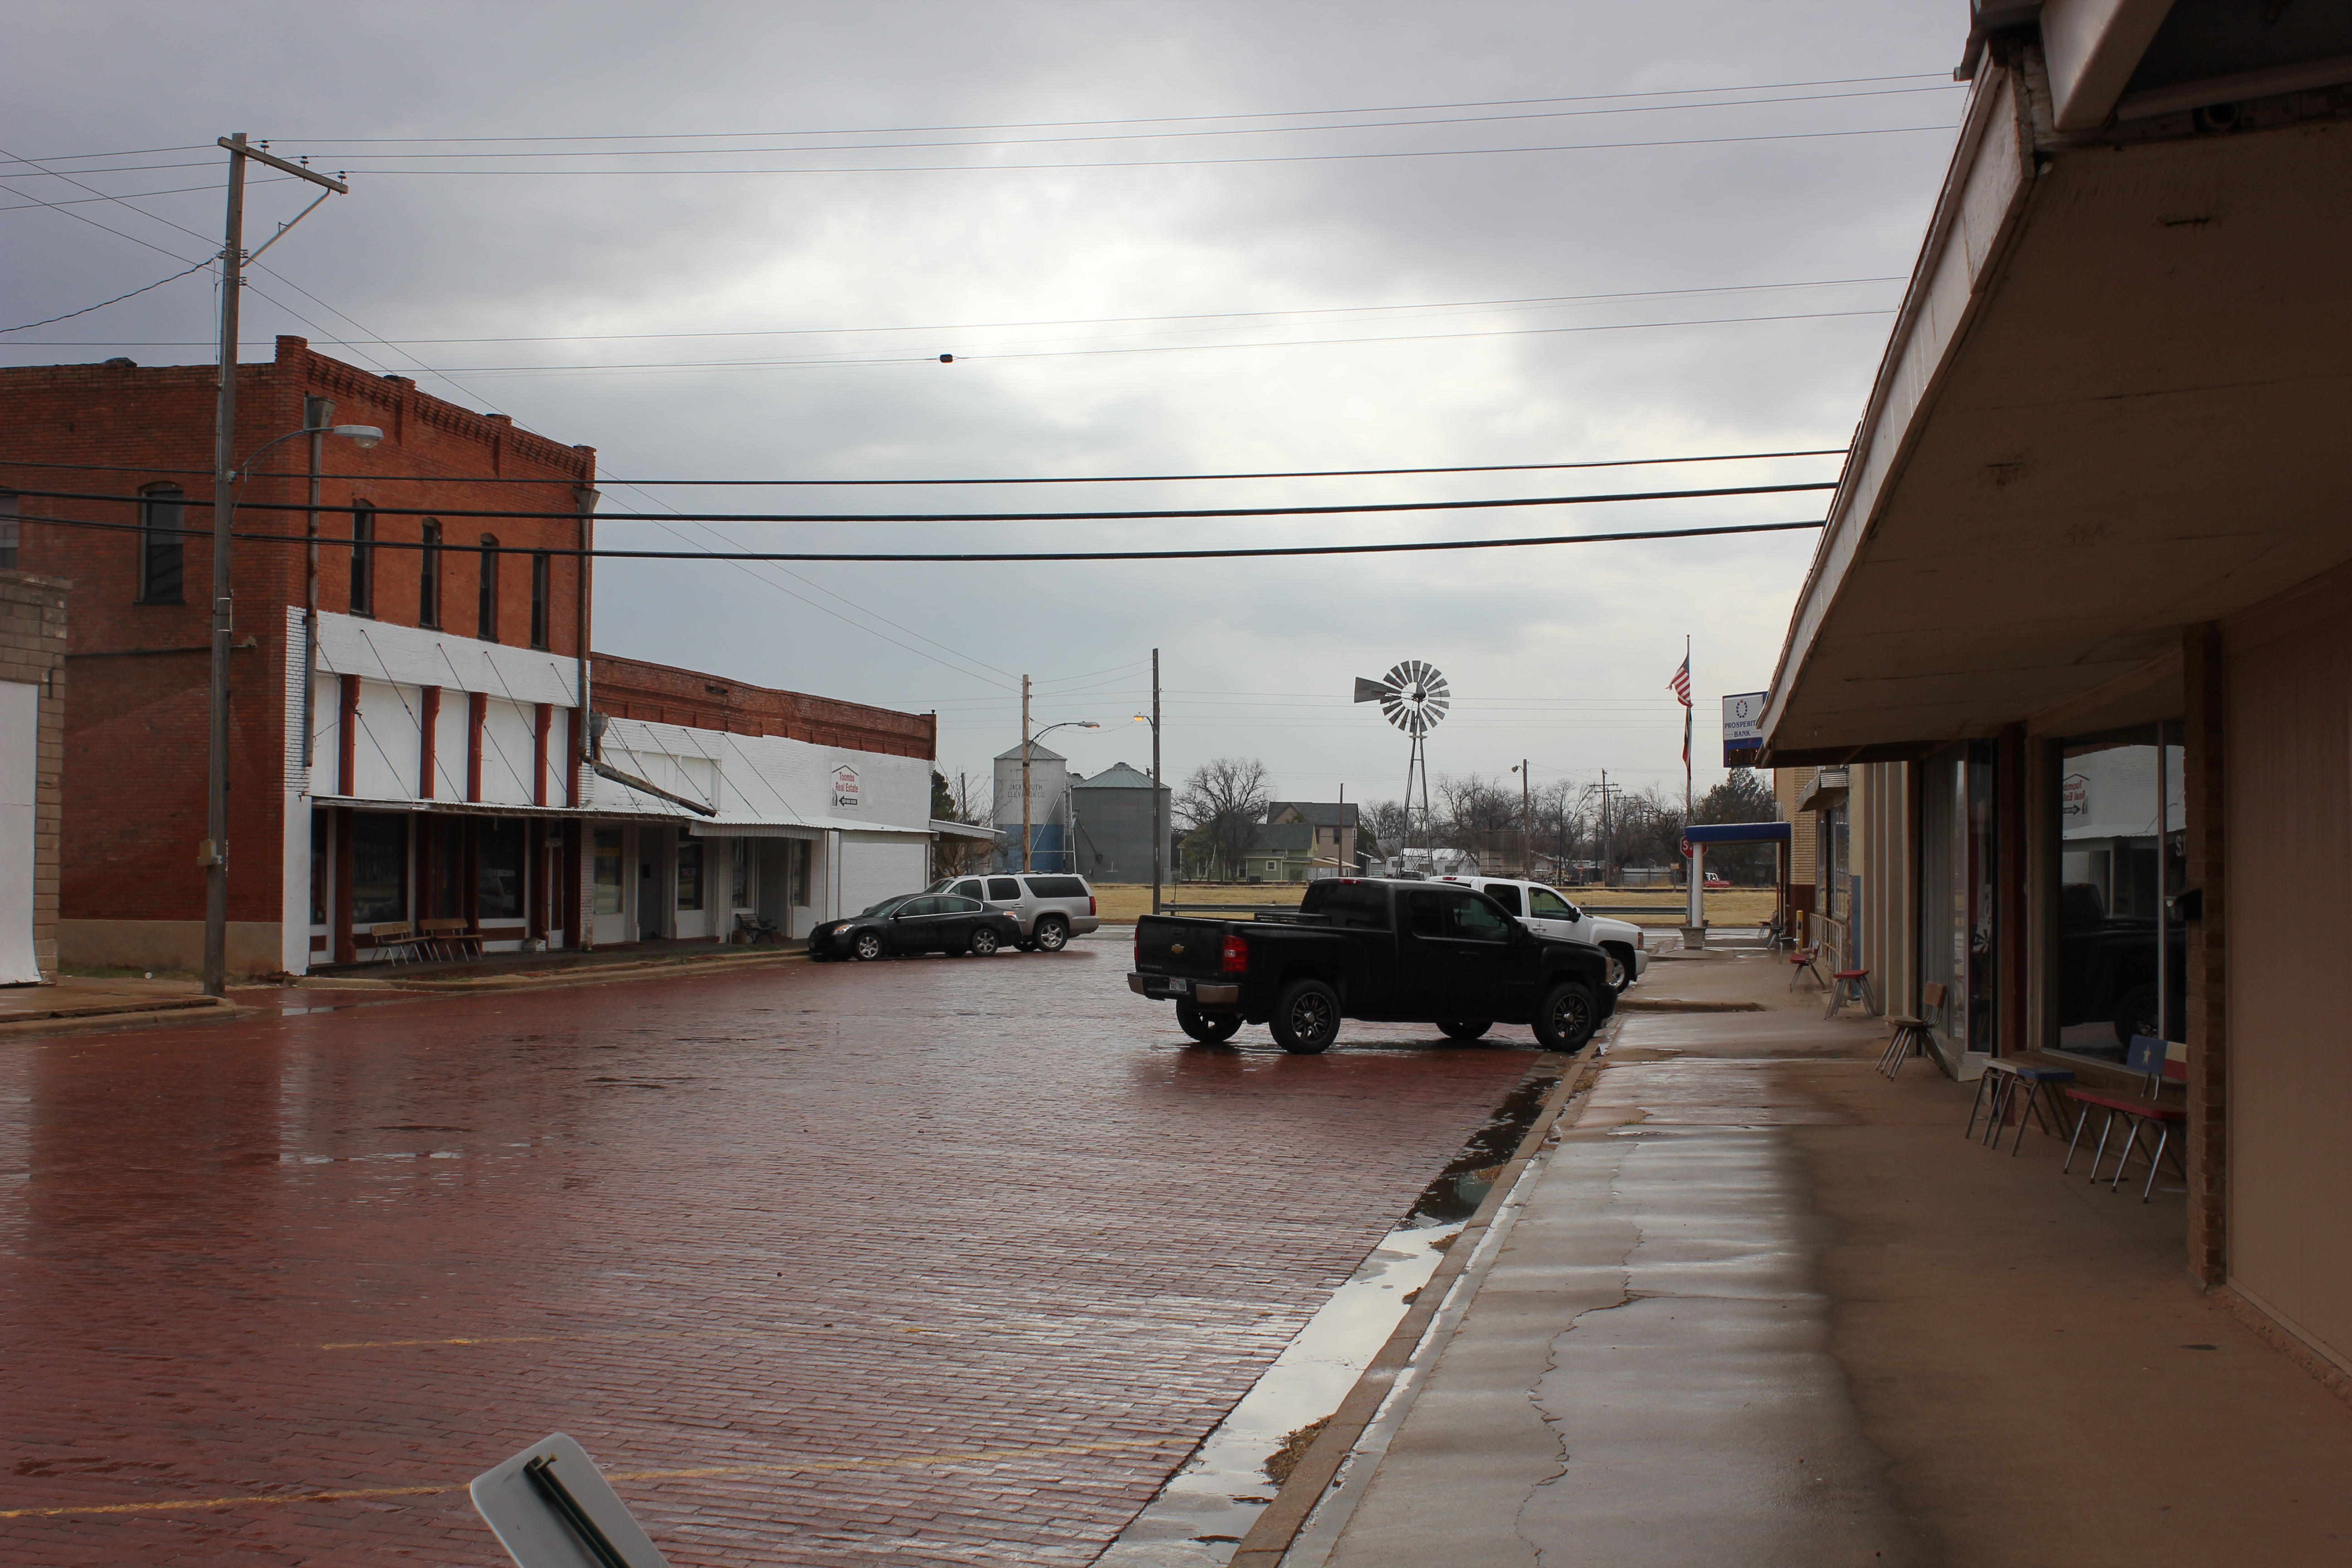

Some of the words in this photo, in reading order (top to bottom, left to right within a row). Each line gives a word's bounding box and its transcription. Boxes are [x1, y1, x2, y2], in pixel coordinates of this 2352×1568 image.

[1725, 720, 1757, 729] PROSPERIT
[839, 772, 855, 782] Toombs
[836, 782, 845, 792] Real
[846, 783, 858, 793] Estate
